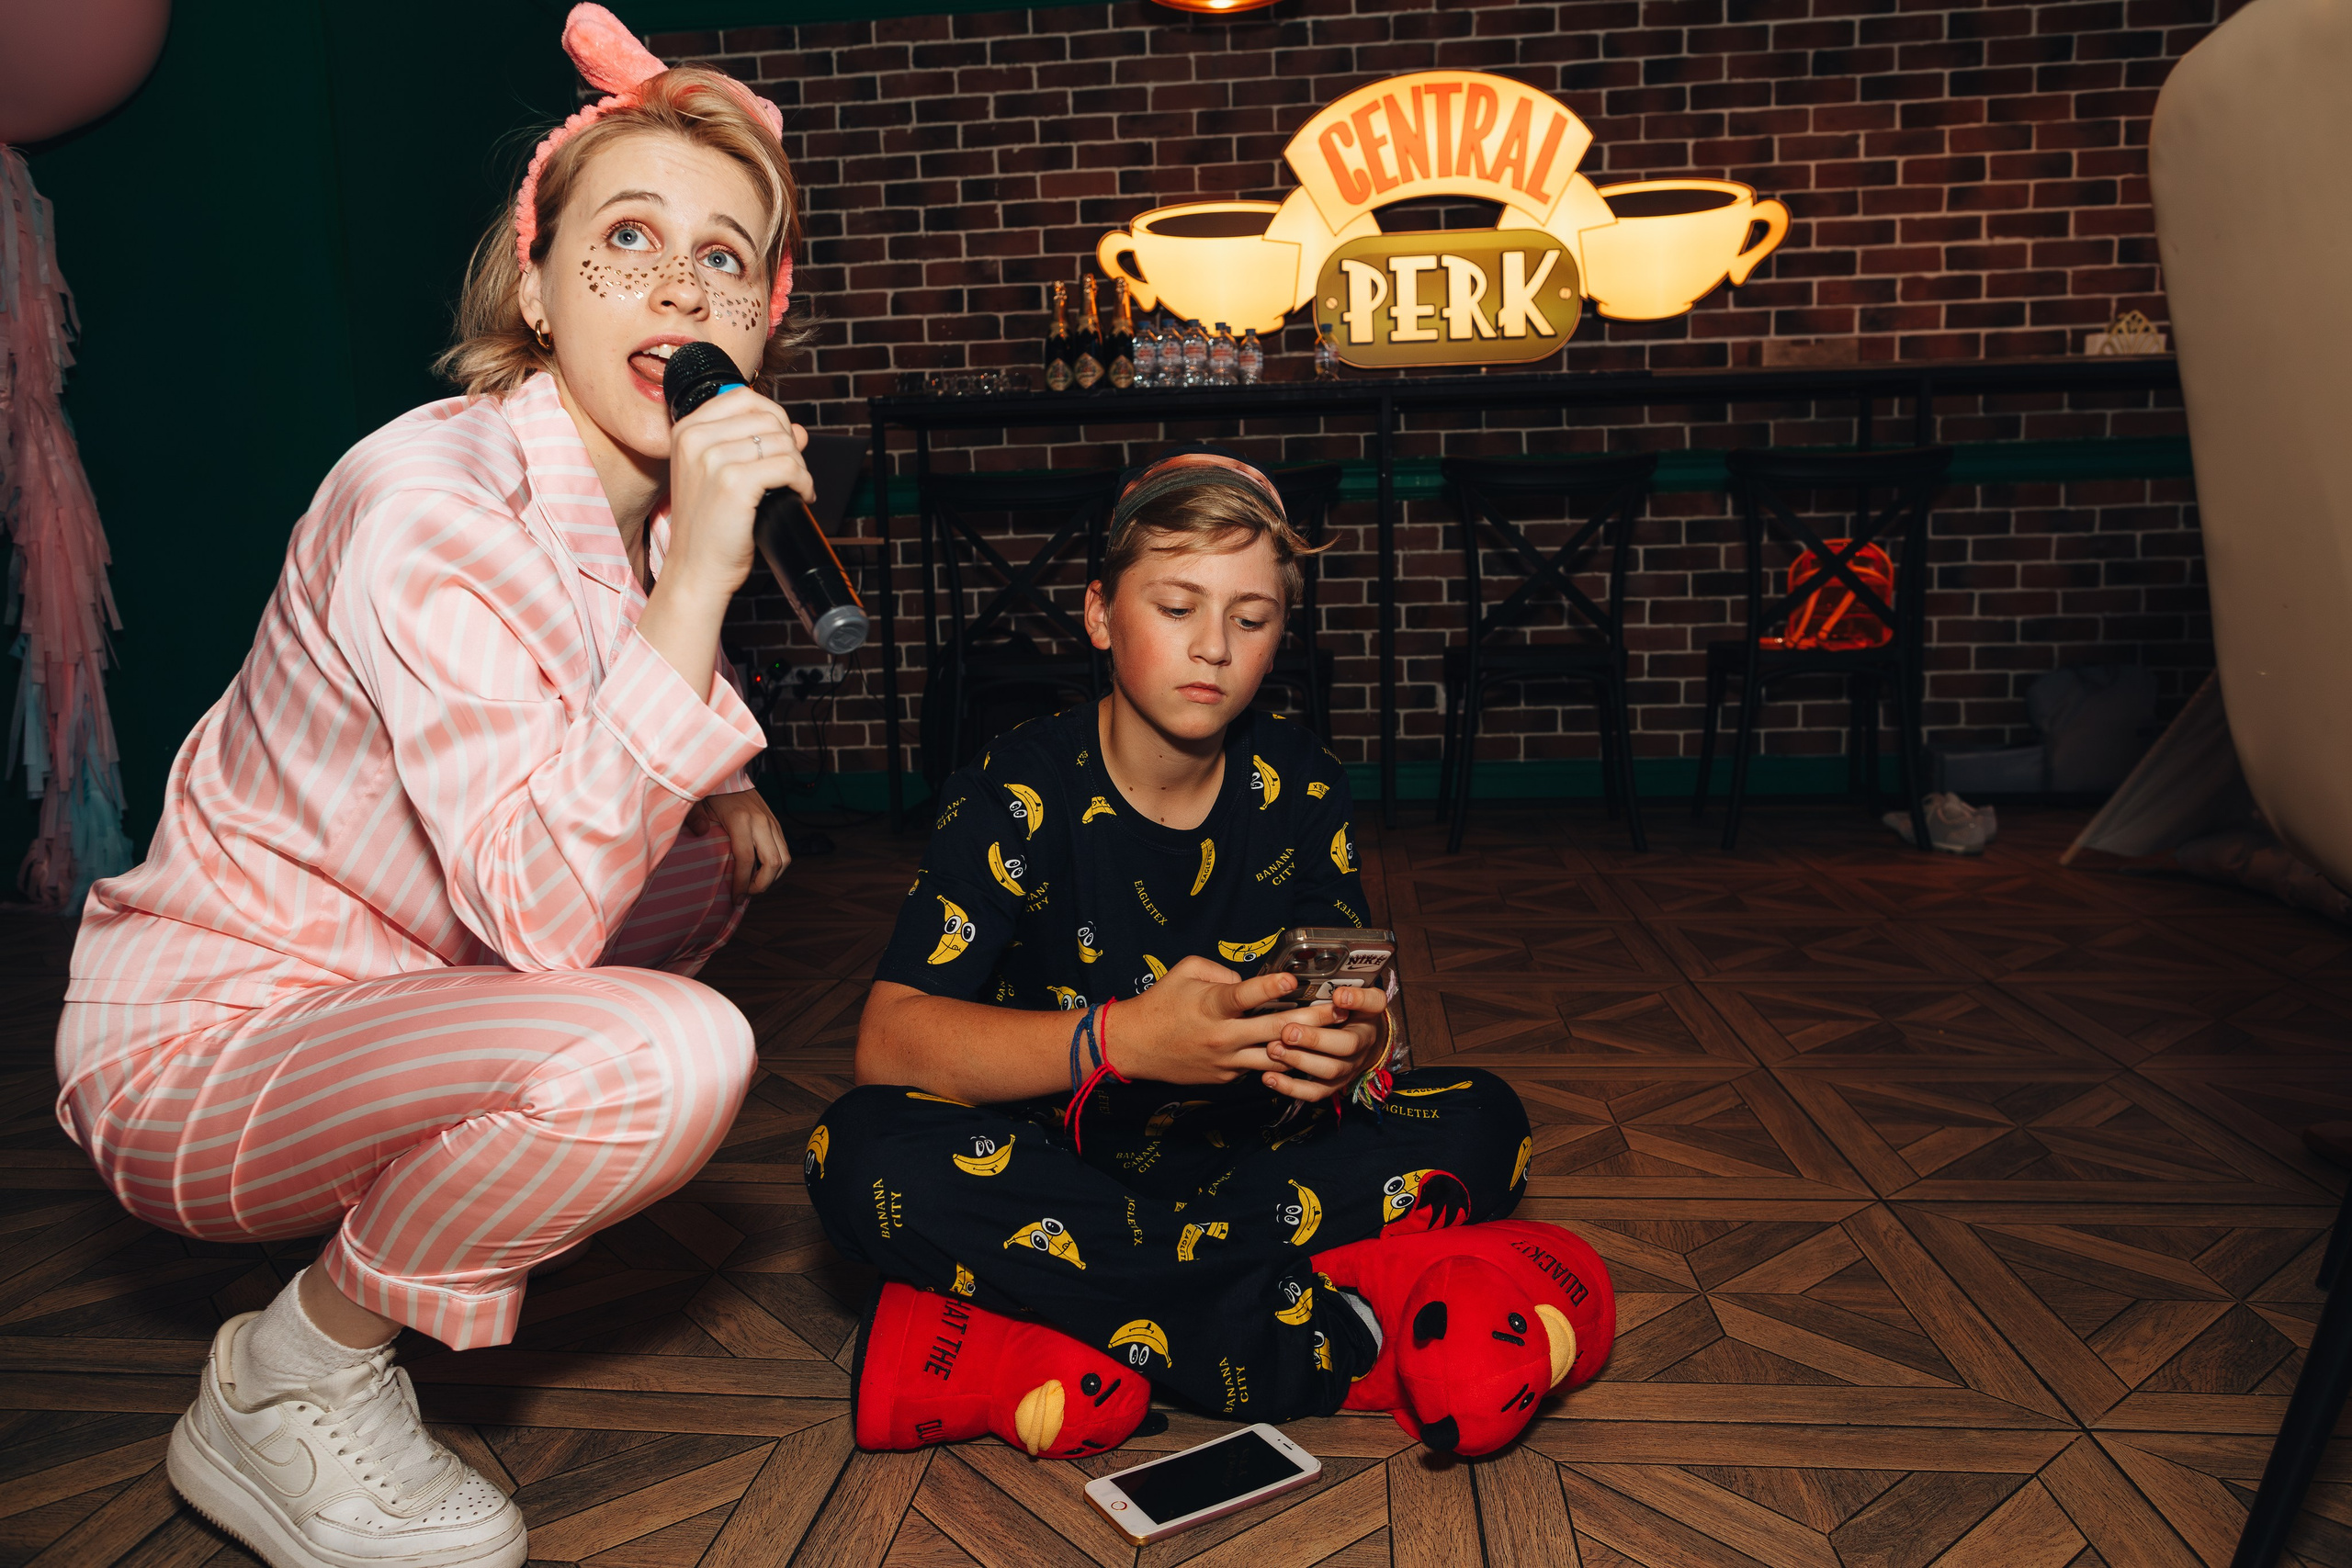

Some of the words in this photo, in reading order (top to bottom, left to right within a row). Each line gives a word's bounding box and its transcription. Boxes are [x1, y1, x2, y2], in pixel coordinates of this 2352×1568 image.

[1318, 83, 1568, 206] CENTRAL
[1341, 249, 1561, 344] PERK
[1255, 848, 1295, 882] BANANA
[1272, 862, 1295, 886] CITY
[1134, 879, 1168, 926] EAGLETEX
[1333, 899, 1363, 929] GLETEX
[1346, 953, 1387, 965] NIKE
[1138, 1151, 1161, 1173] CITY
[873, 1178, 890, 1238] BANANA
[891, 1191, 903, 1228] CITY
[942, 1298, 971, 1335] HAT
[923, 1336, 963, 1381] THE
[1218, 1357, 1236, 1414] BANANA
[1236, 1365, 1250, 1404] CITY
